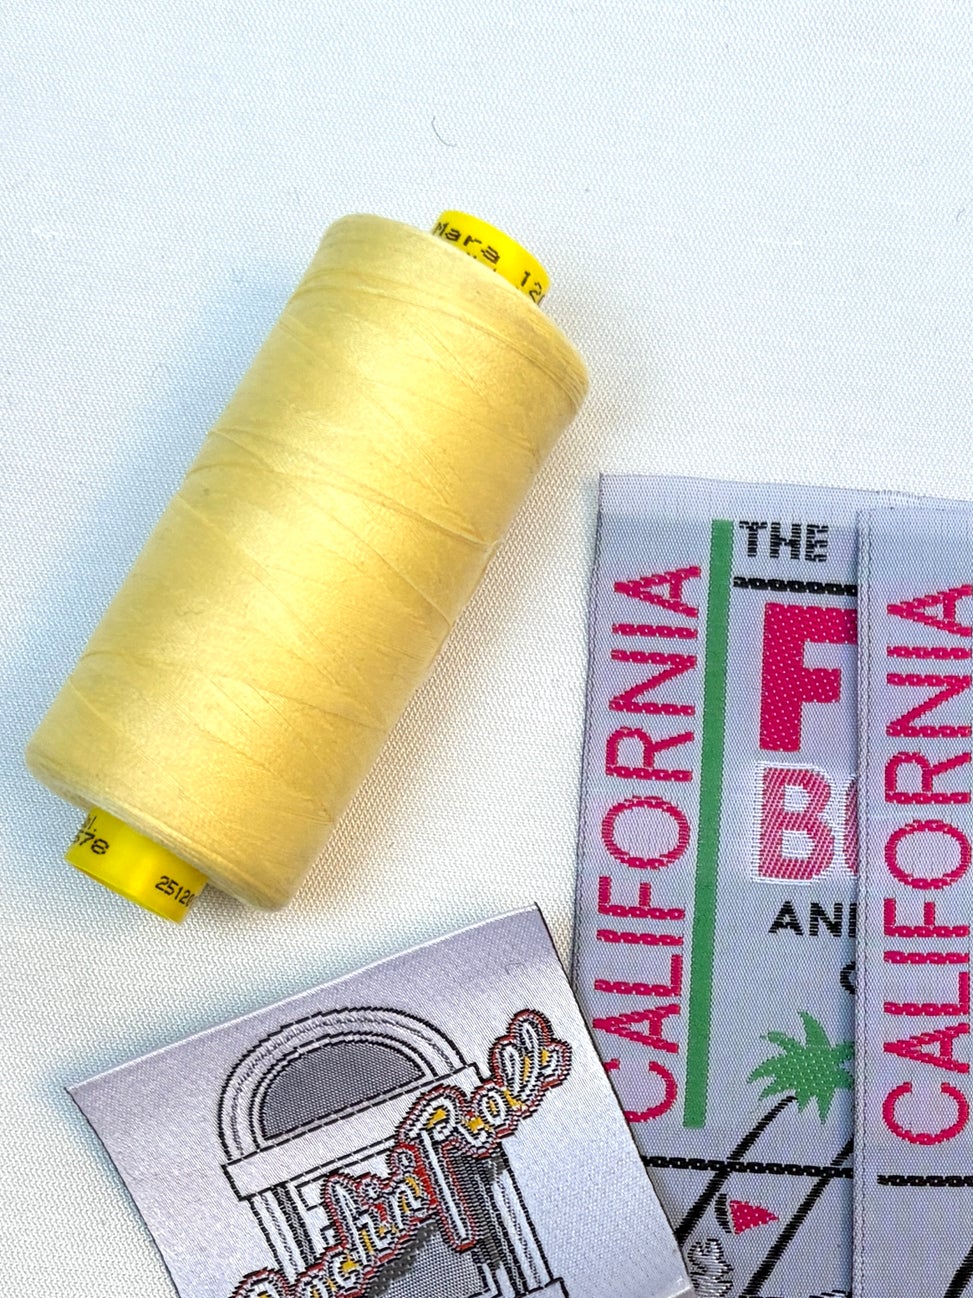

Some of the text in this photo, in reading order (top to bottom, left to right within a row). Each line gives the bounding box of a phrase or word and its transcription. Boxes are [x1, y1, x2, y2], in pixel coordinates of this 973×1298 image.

[432, 221, 500, 264] Mara
[739, 520, 829, 563] THE
[593, 565, 702, 1127] CALIFORNIA
